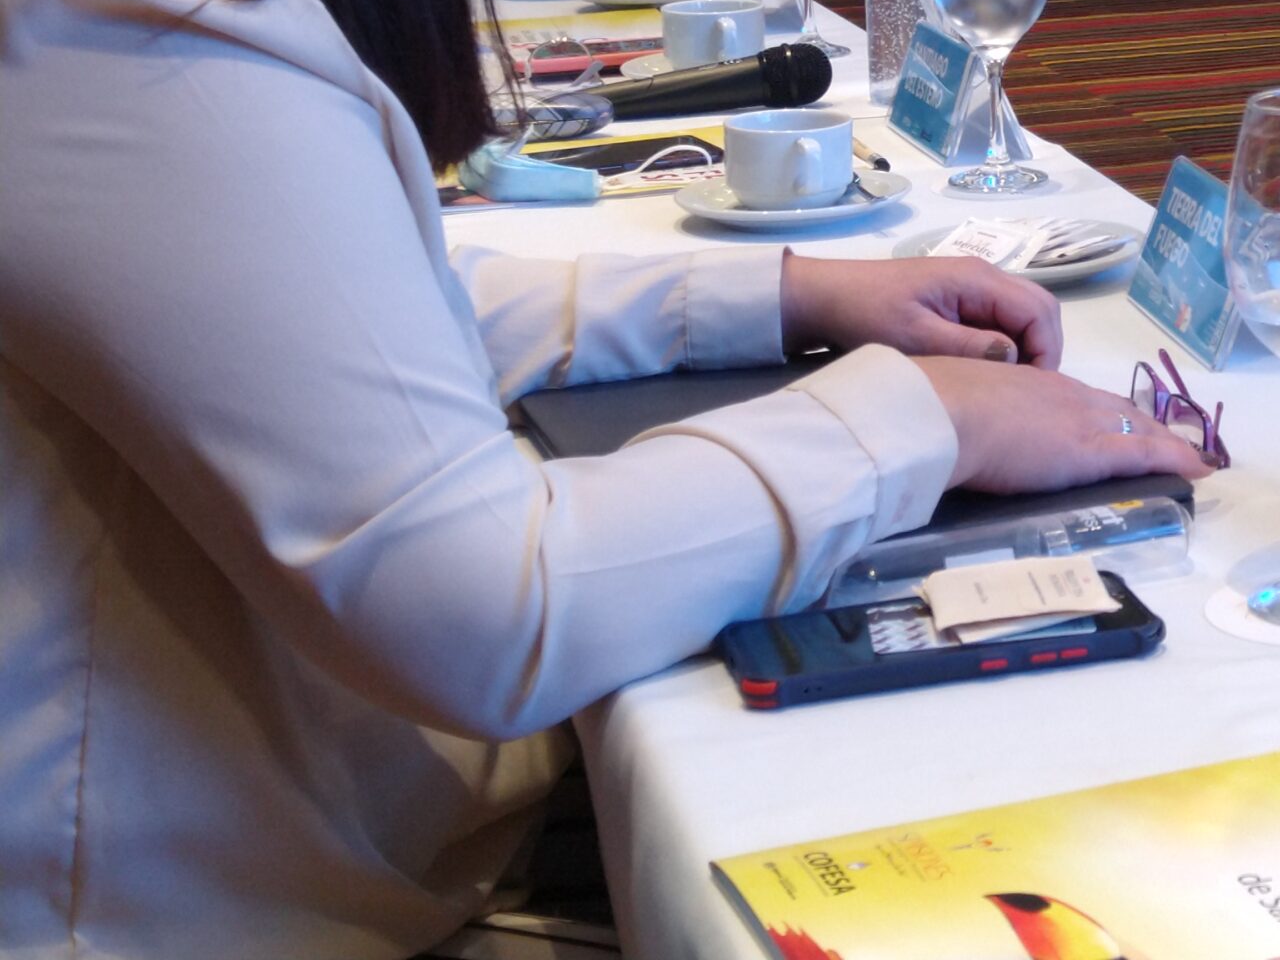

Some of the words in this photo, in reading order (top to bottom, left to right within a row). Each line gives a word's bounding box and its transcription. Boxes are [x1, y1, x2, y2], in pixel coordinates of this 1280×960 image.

[1166, 186, 1203, 233] TIERRA
[1200, 209, 1223, 248] DEL
[1152, 223, 1190, 269] FUEGO
[803, 850, 856, 897] COFESA
[1237, 872, 1273, 896] de
